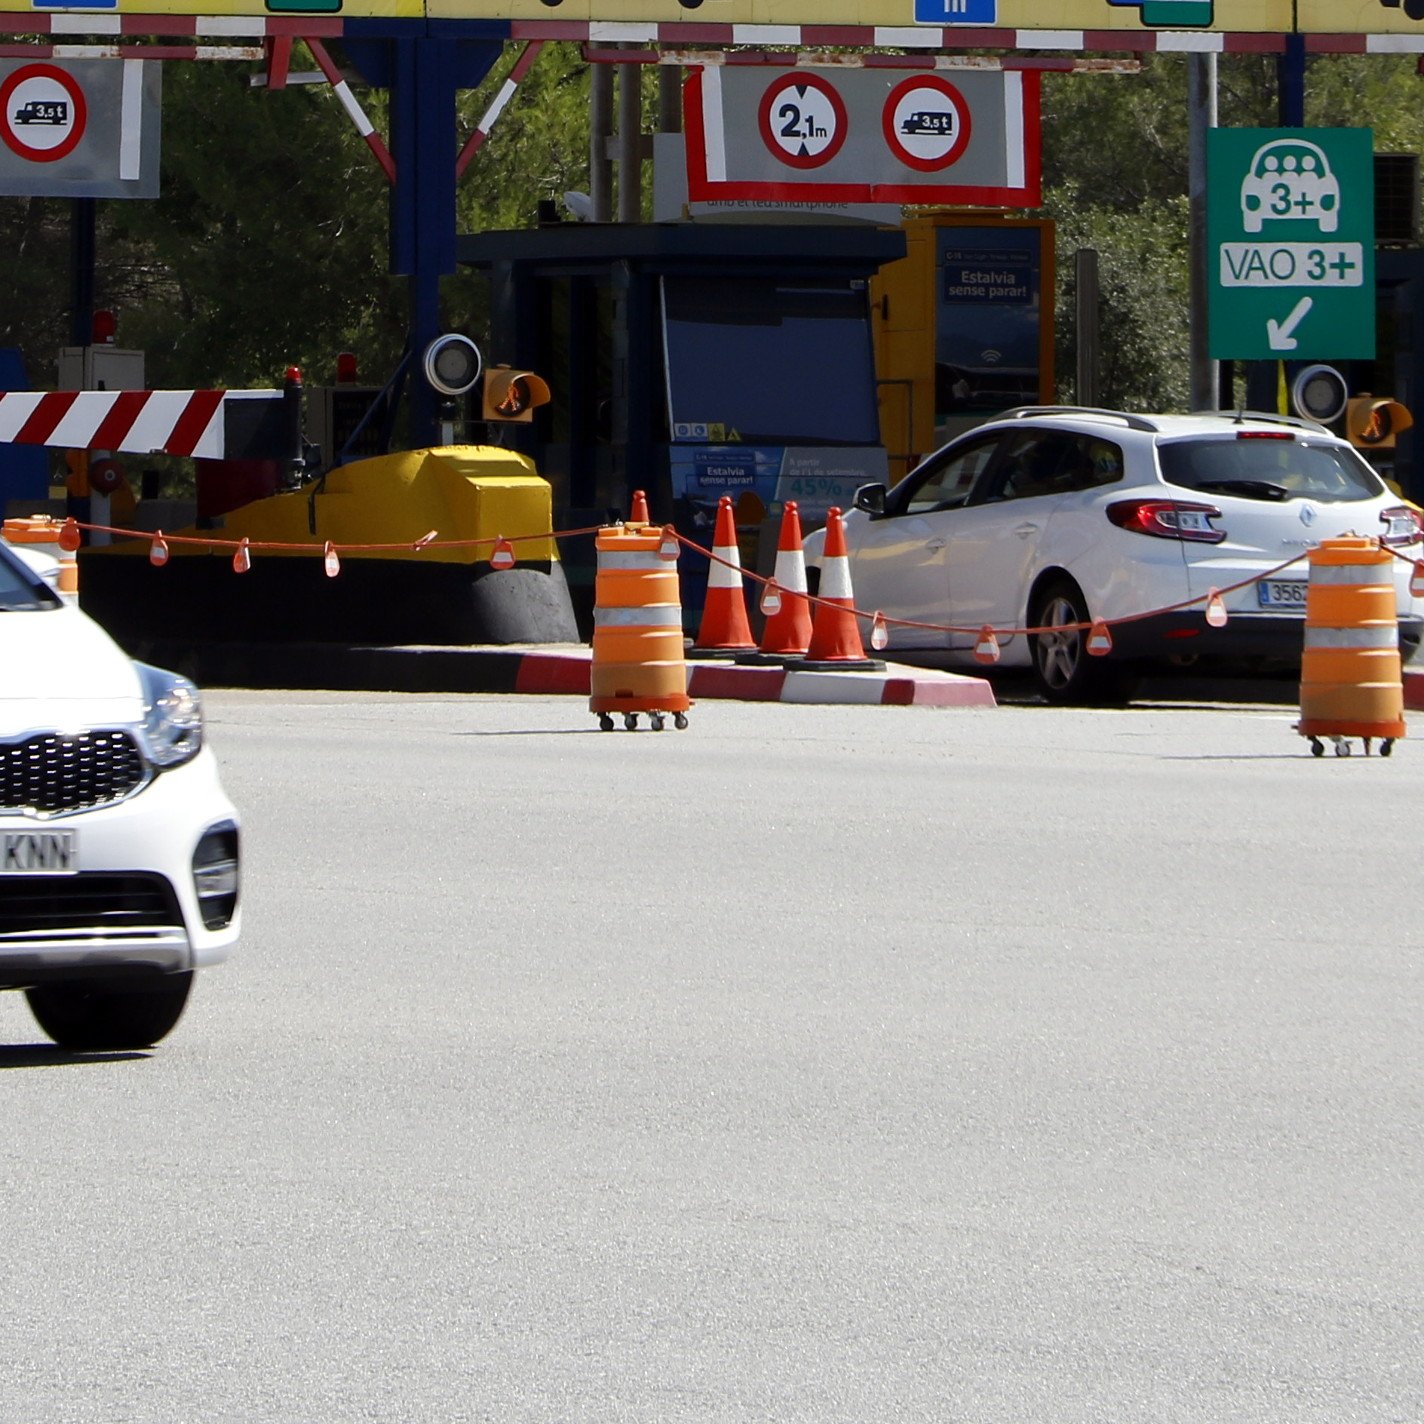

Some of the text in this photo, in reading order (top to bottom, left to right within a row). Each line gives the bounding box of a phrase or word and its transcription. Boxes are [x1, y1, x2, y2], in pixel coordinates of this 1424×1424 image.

[1270, 182, 1314, 215] 3+
[1224, 248, 1356, 281] VAO 3+
[961, 270, 1016, 284] Estalvia
[948, 286, 1027, 299] sense parar!
[707, 466, 745, 476] Estalvia
[791, 478, 842, 495] 45%
[5, 833, 72, 869] KNN
